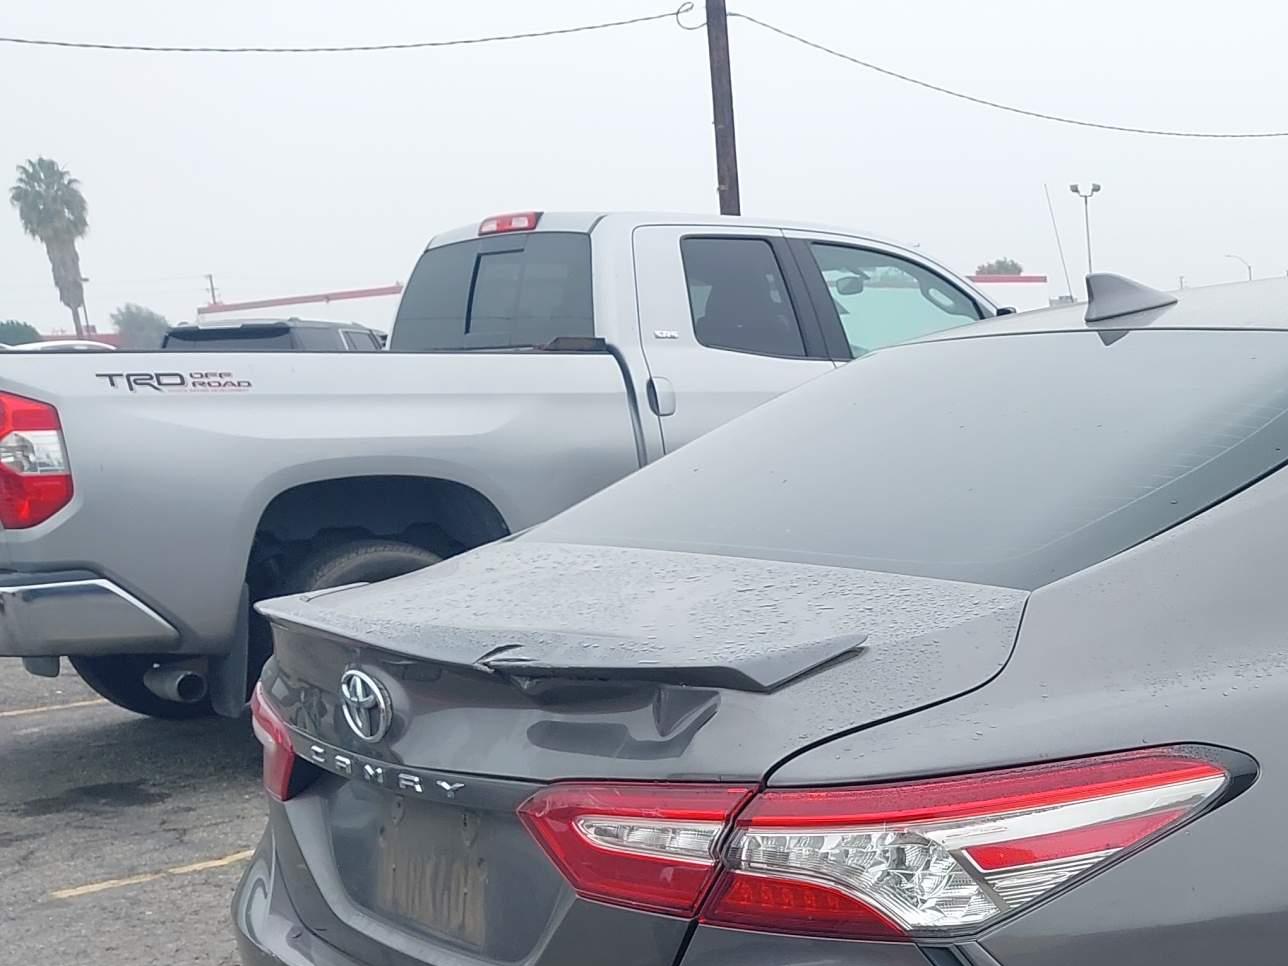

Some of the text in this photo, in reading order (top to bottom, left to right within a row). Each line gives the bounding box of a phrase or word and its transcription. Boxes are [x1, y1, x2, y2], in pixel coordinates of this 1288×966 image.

[95, 372, 186, 392] TRD
[191, 380, 252, 388] ROAD
[310, 744, 466, 800] CAMRY
